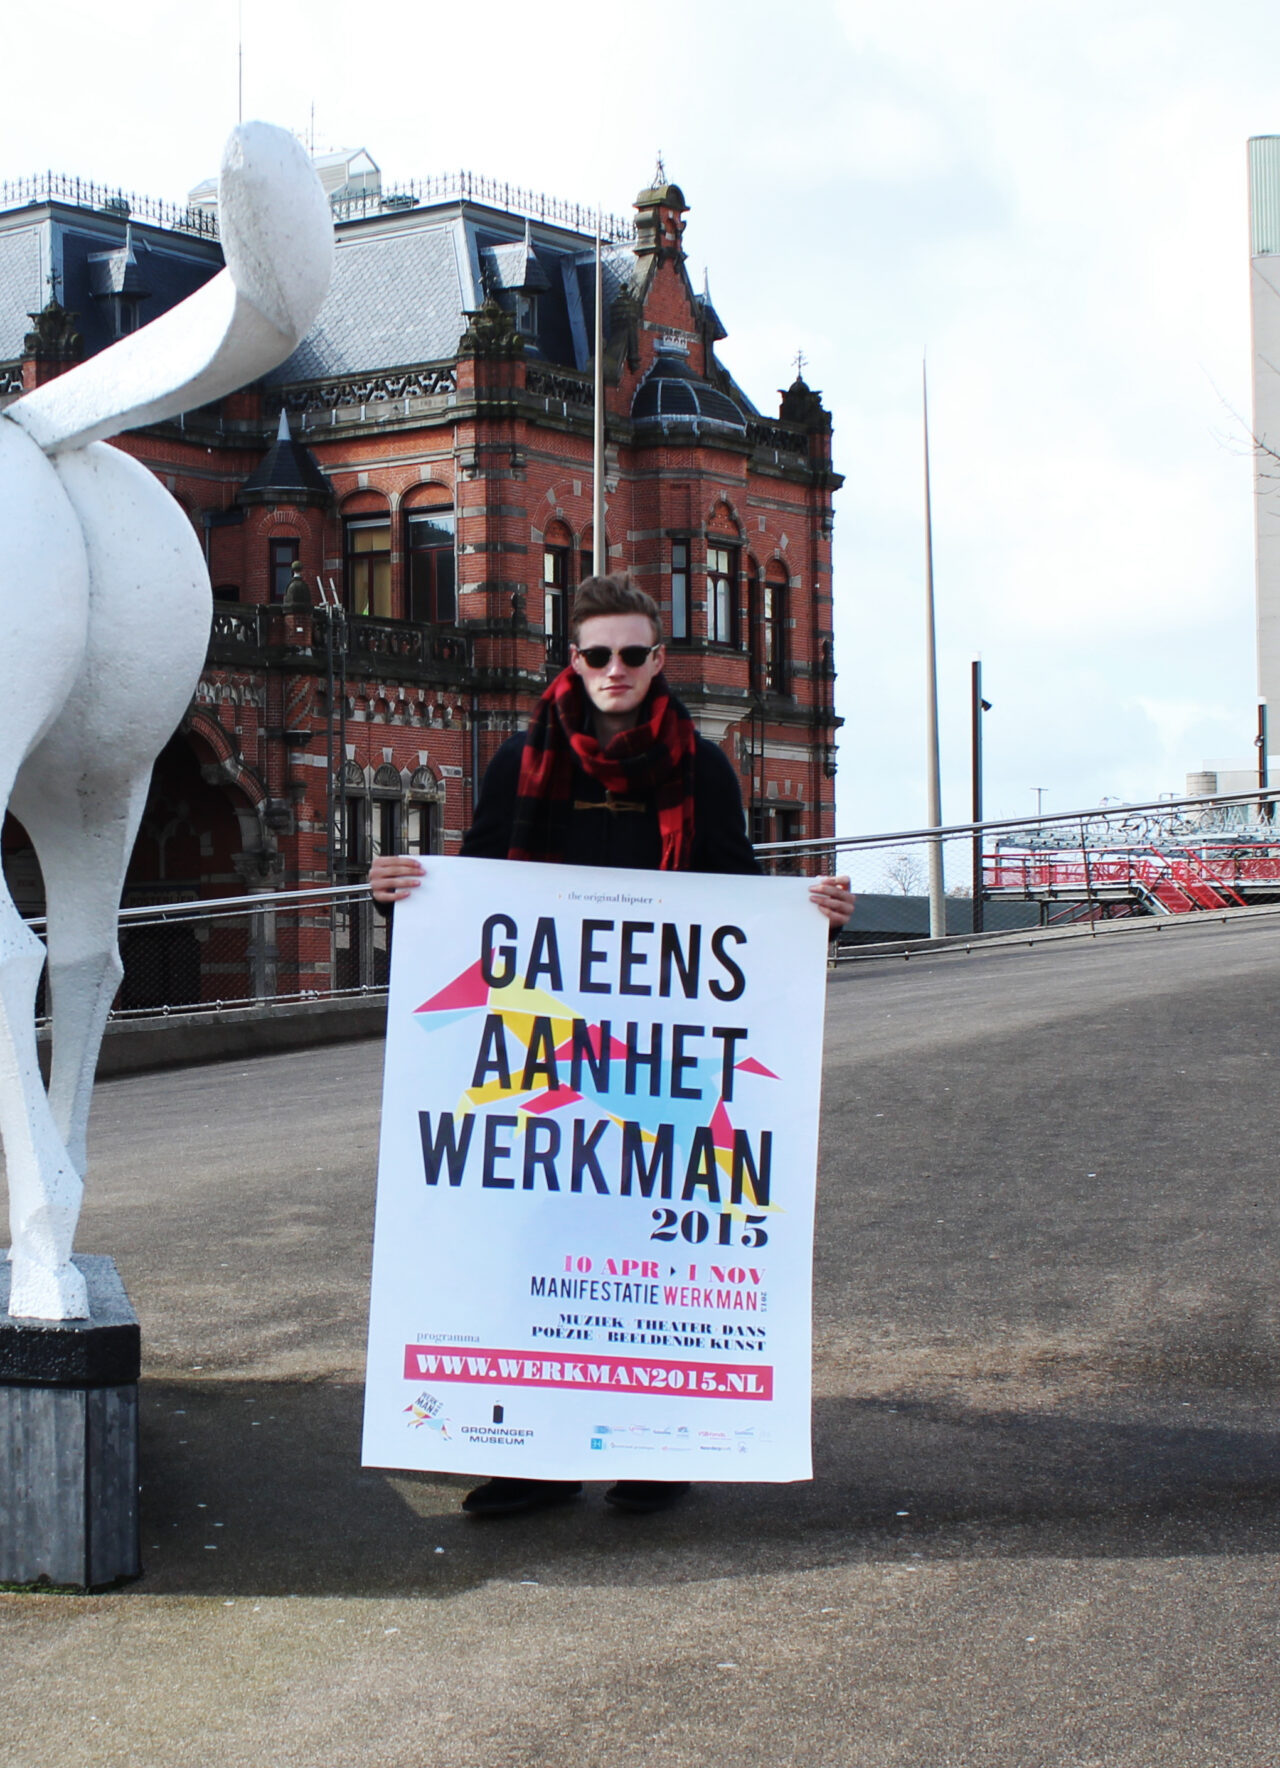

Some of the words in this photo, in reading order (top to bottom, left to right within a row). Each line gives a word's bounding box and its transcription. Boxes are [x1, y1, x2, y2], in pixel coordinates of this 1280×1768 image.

[568, 891, 581, 901] the
[583, 892, 620, 904] original
[621, 894, 653, 905] hipster
[481, 913, 563, 992] GA
[579, 918, 747, 1002] EENS
[471, 1014, 612, 1094] AAN
[625, 1021, 748, 1103] HET
[418, 1110, 773, 1207] WERKMAN
[650, 1207, 769, 1249] 2015
[564, 1255, 593, 1274] 10
[601, 1258, 660, 1279] APR
[688, 1264, 697, 1282] 1
[709, 1265, 767, 1286] NOV
[530, 1276, 660, 1306] MANIFESTATIE
[663, 1285, 758, 1312] WERKMAN
[416, 1331, 480, 1343] programma
[558, 1313, 625, 1328] MUZIEK
[634, 1318, 713, 1335] THEATER
[722, 1325, 767, 1338] DANS
[607, 1331, 706, 1349] BEELDENDE
[710, 1338, 767, 1352] KUNST
[416, 1354, 765, 1394] WWW.WERKMAN2015.NL
[461, 1425, 534, 1438] GRONINGER
[469, 1434, 525, 1446] MUSEUM
